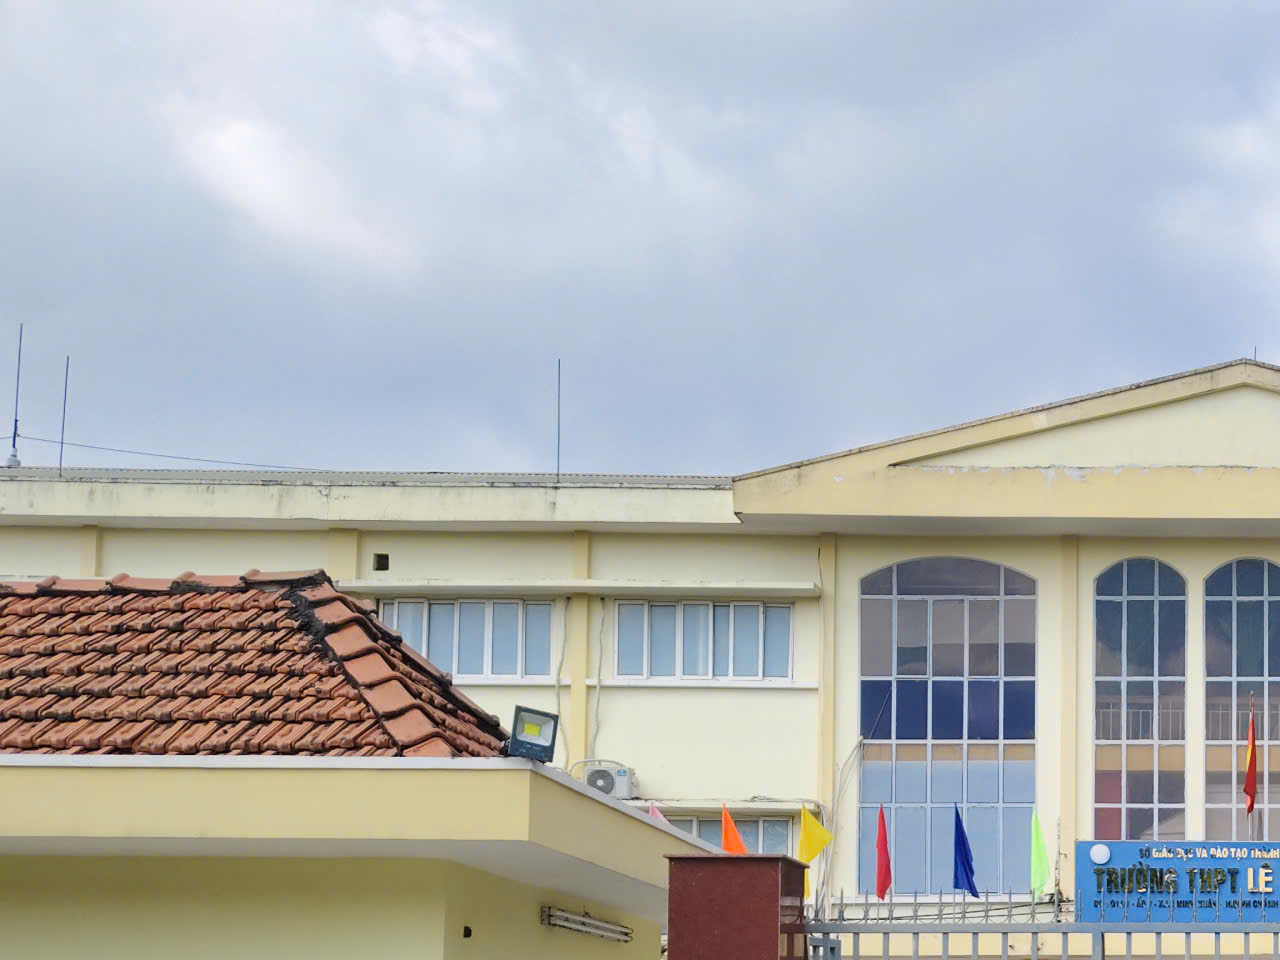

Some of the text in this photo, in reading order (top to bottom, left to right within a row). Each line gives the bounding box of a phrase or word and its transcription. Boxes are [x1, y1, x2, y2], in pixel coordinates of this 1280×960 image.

[1139, 843, 1151, 859] SỞ
[1152, 845, 1174, 858] GIÁO
[1176, 847, 1194, 862] DỤC
[1196, 845, 1208, 858] VÀ
[1210, 845, 1229, 859] ĐÀO
[1230, 847, 1248, 861] TẠO
[1250, 845, 1280, 859] THÀNH
[1093, 861, 1177, 893] TRƯỜNG
[1186, 867, 1239, 893] THPT
[1247, 862, 1273, 893] LÊ
